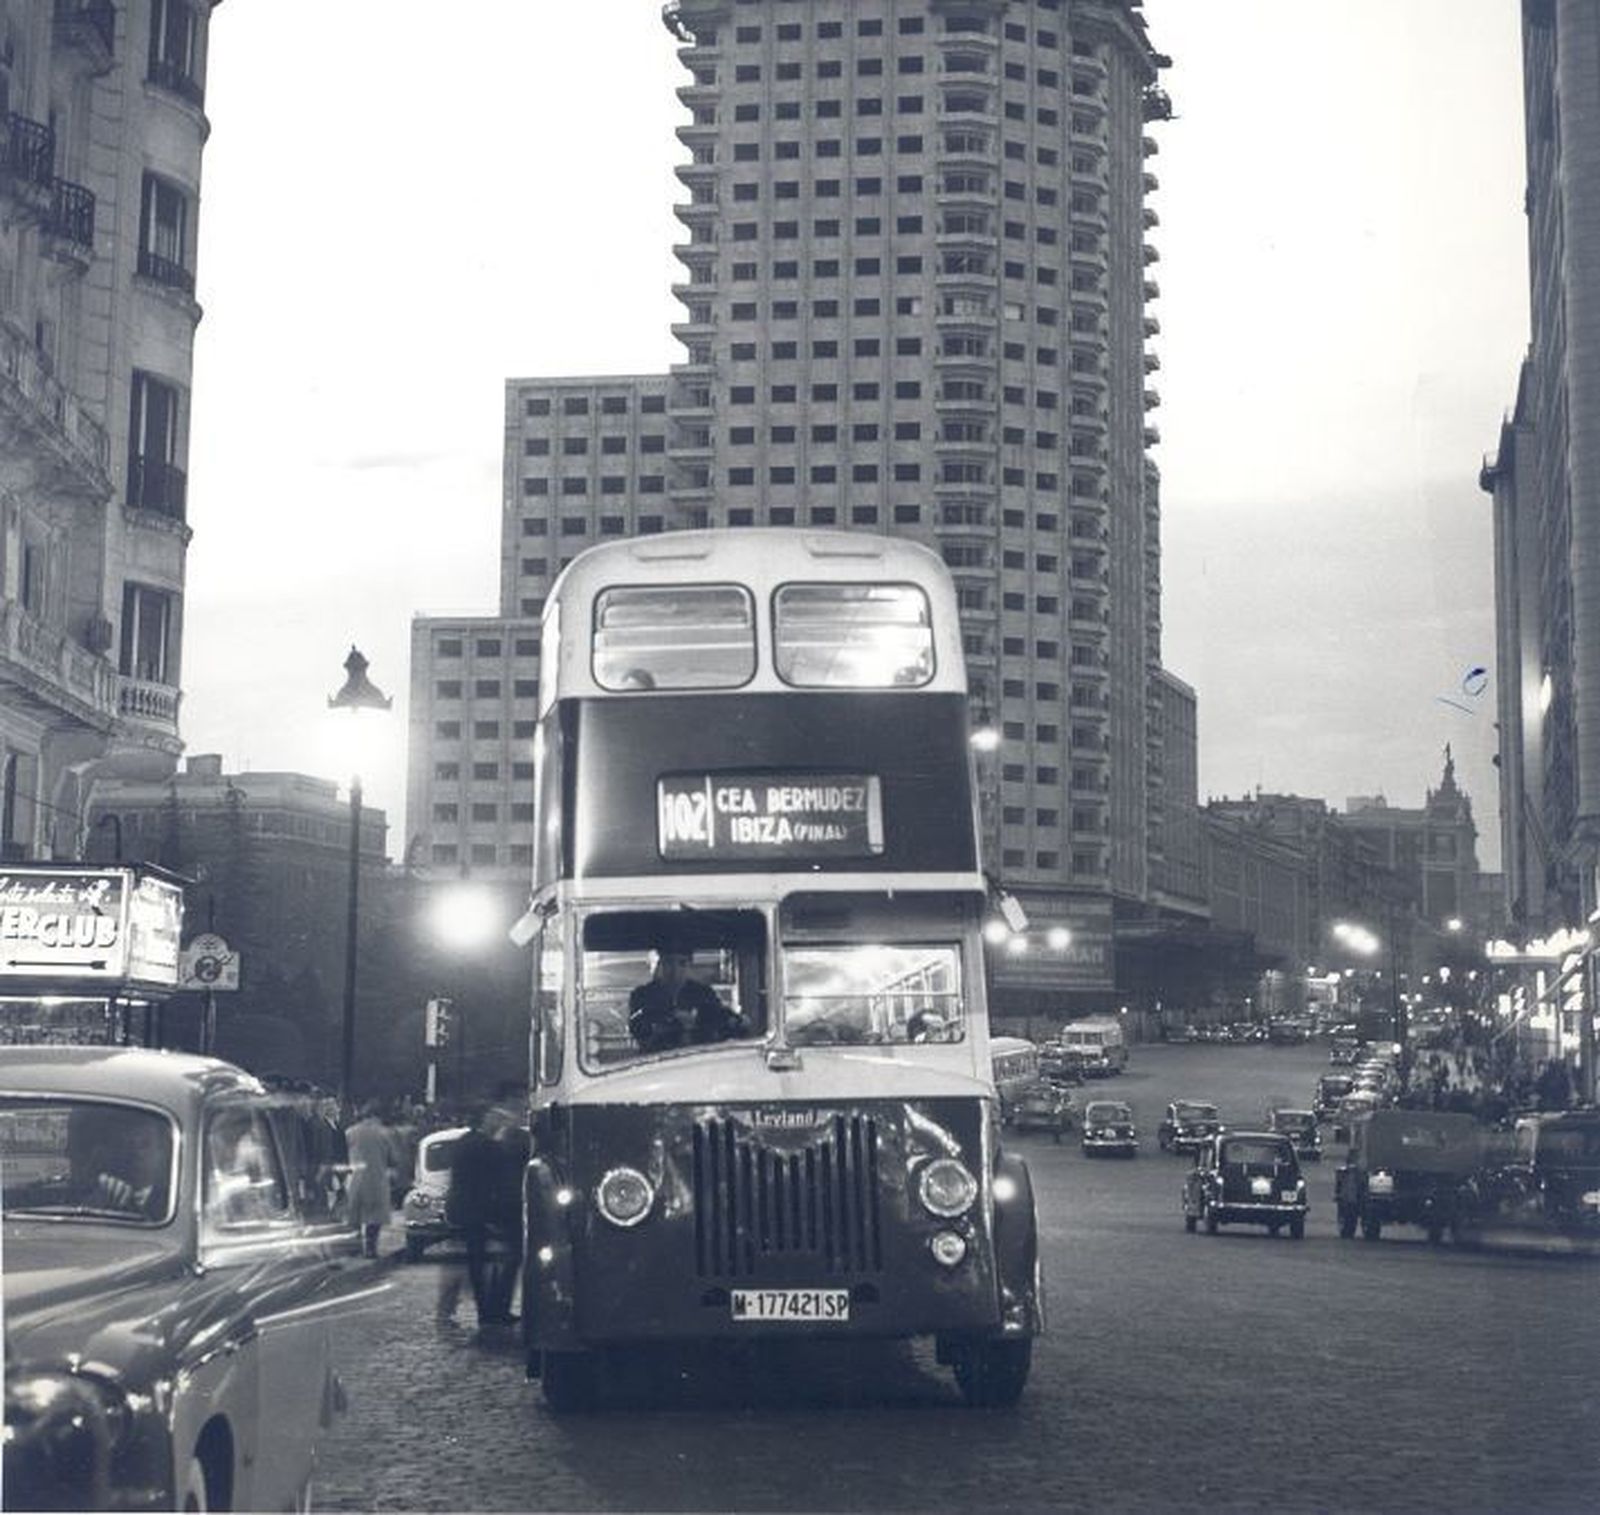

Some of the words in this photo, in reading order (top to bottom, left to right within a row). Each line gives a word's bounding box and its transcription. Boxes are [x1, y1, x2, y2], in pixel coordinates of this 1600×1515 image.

[717, 788, 756, 813] CEA
[767, 787, 865, 813] BERMUDEZ
[663, 792, 706, 841] 102
[731, 816, 793, 844] IBIZA
[758, 1110, 815, 1130] Leyland
[734, 1293, 820, 1316] M-177421
[825, 1294, 848, 1316] SP
